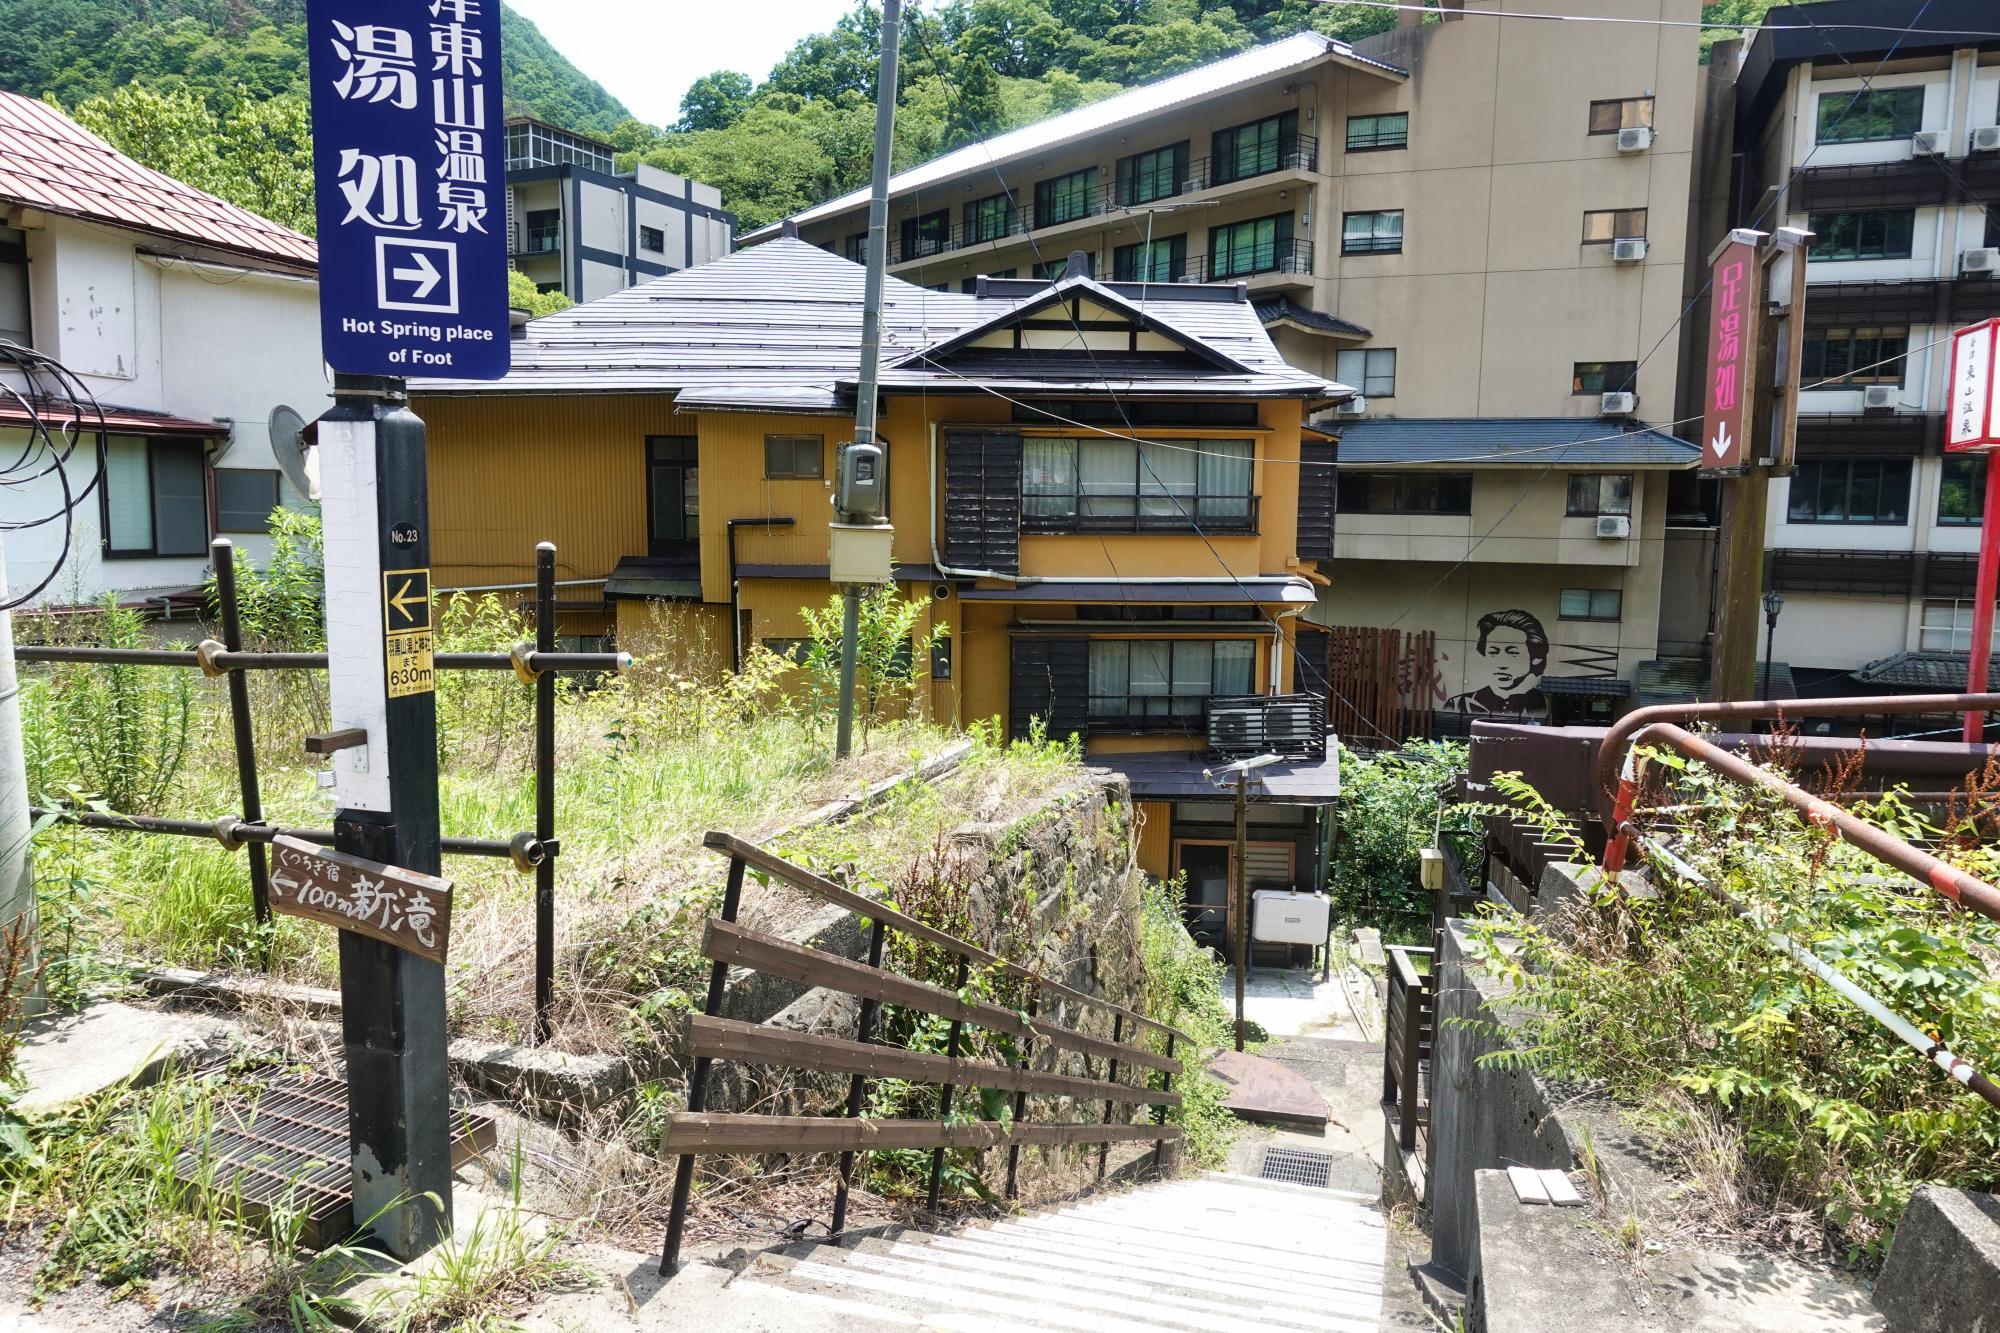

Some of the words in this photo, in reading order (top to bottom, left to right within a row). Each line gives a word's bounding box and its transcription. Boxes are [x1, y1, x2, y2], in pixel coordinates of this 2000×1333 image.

[330, 19, 423, 231] 湯処
[342, 317, 376, 334] Hot
[381, 320, 441, 342] Spring
[446, 325, 494, 342] place
[1713, 261, 1743, 412] 足湯処
[388, 348, 408, 363] of
[412, 350, 453, 366] Foot
[391, 529, 418, 544] No.23
[402, 655, 418, 668] まで
[391, 667, 432, 686] 630m
[279, 848, 341, 882] くつろぎ宿
[350, 874, 437, 948] 新滝
